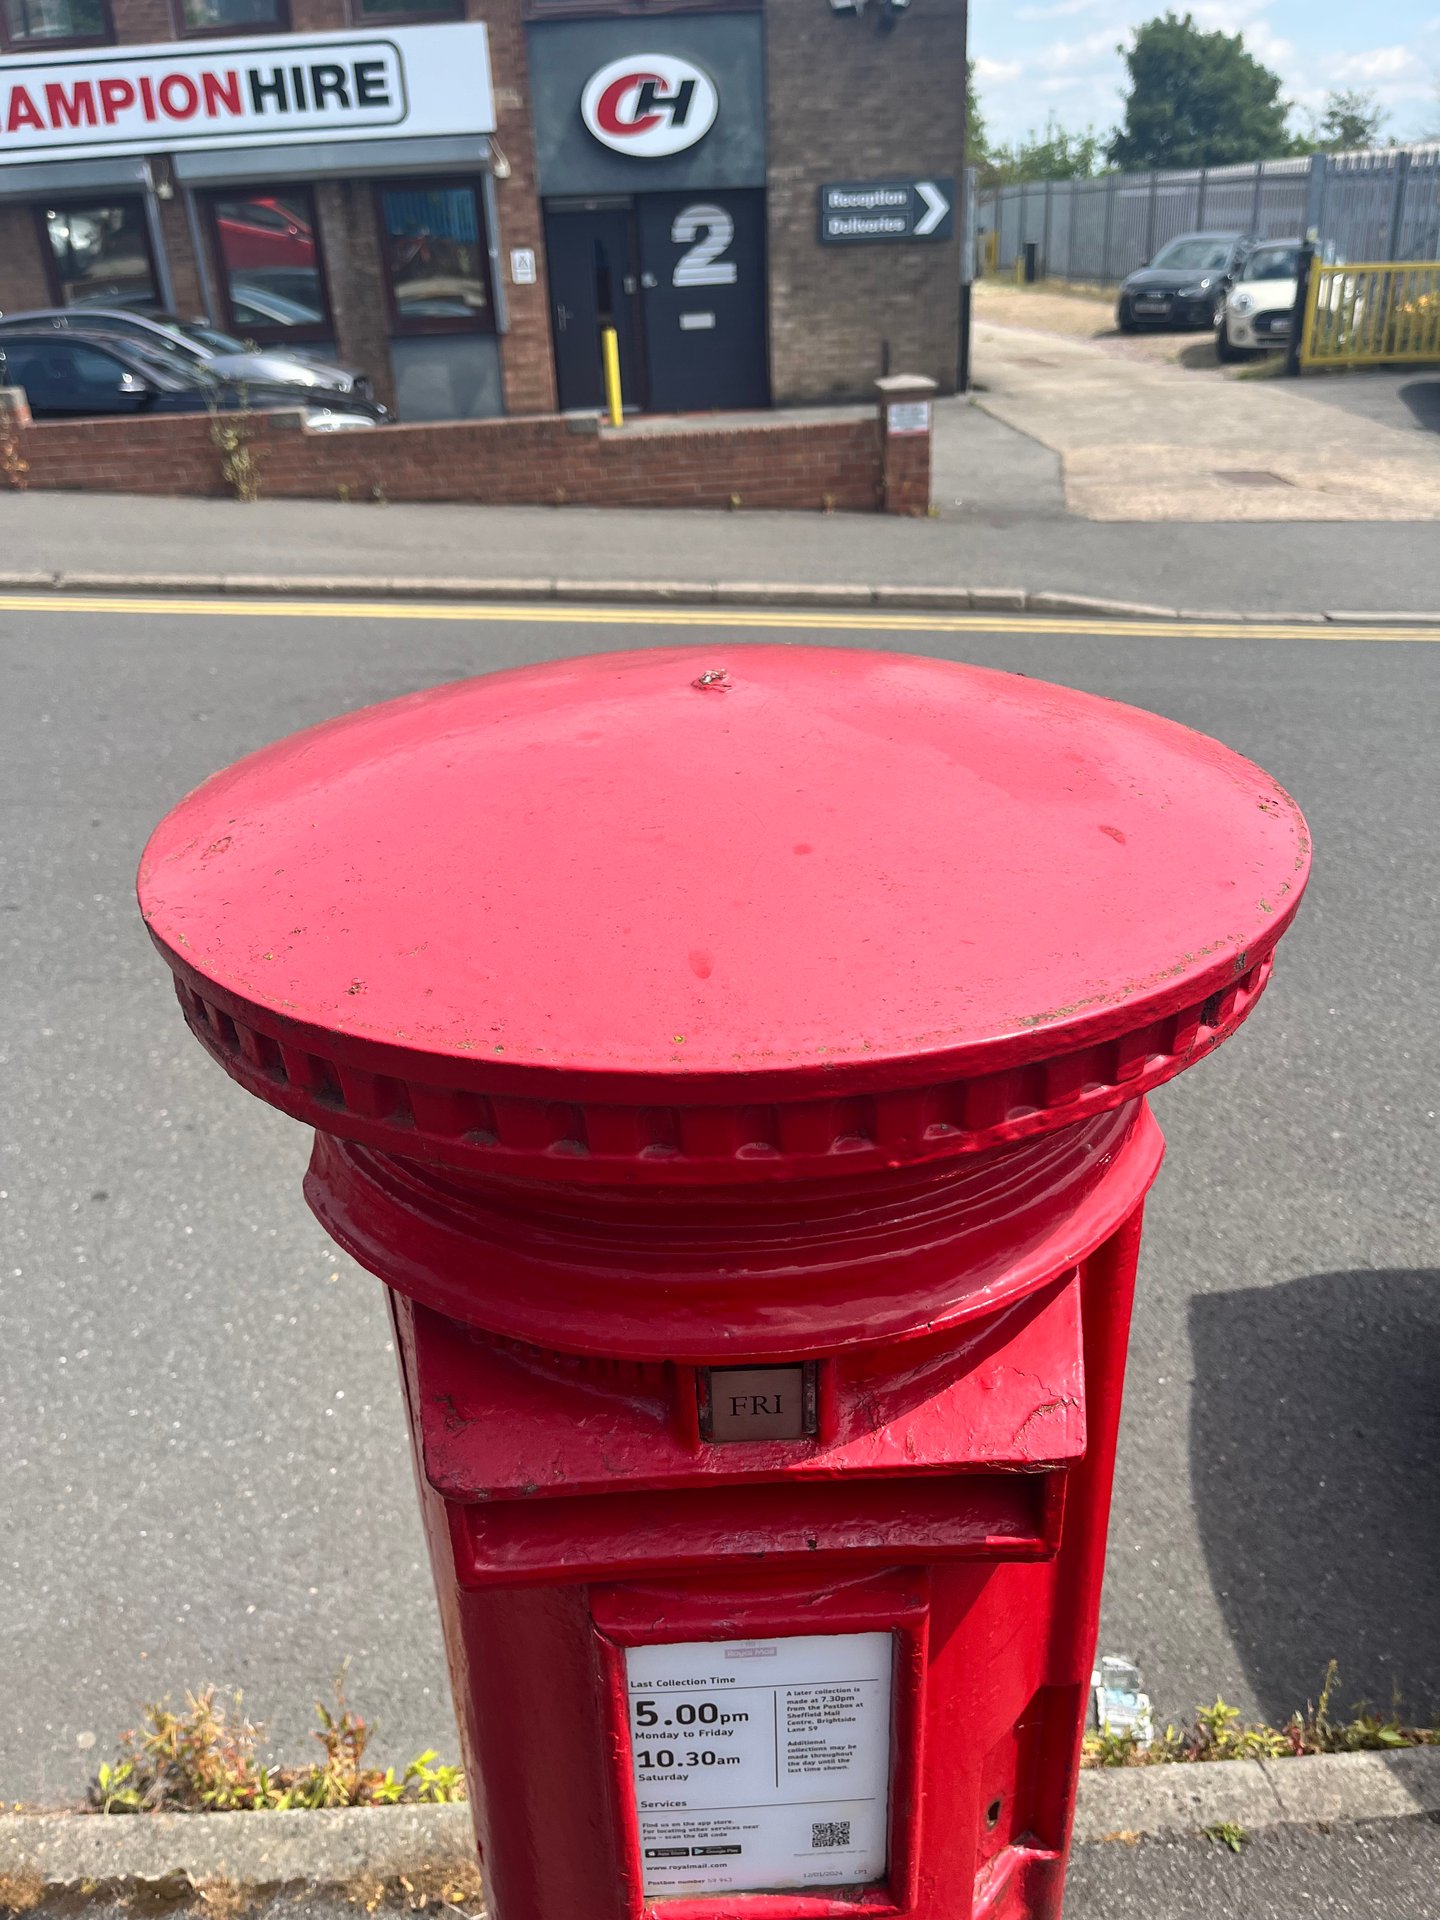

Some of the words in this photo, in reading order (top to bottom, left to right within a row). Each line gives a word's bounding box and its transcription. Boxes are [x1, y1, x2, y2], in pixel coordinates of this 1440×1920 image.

[597, 73, 695, 135] CH
[828, 189, 907, 209] Reception
[828, 216, 905, 234] Deliveries
[671, 204, 737, 287] 2
[728, 1394, 784, 1416] FRI
[656, 1678, 707, 1687] Collection
[636, 1701, 749, 1726] 5.00pm
[635, 1731, 679, 1740] Monday
[699, 1729, 734, 1737] Friday
[787, 1739, 826, 1747] Additional
[637, 1750, 740, 1768] 10.30am
[811, 1751, 853, 1759] throughout
[638, 1773, 689, 1782] Saturday
[641, 1800, 687, 1808] Services
[646, 1863, 728, 1871] www.royalmail.com
